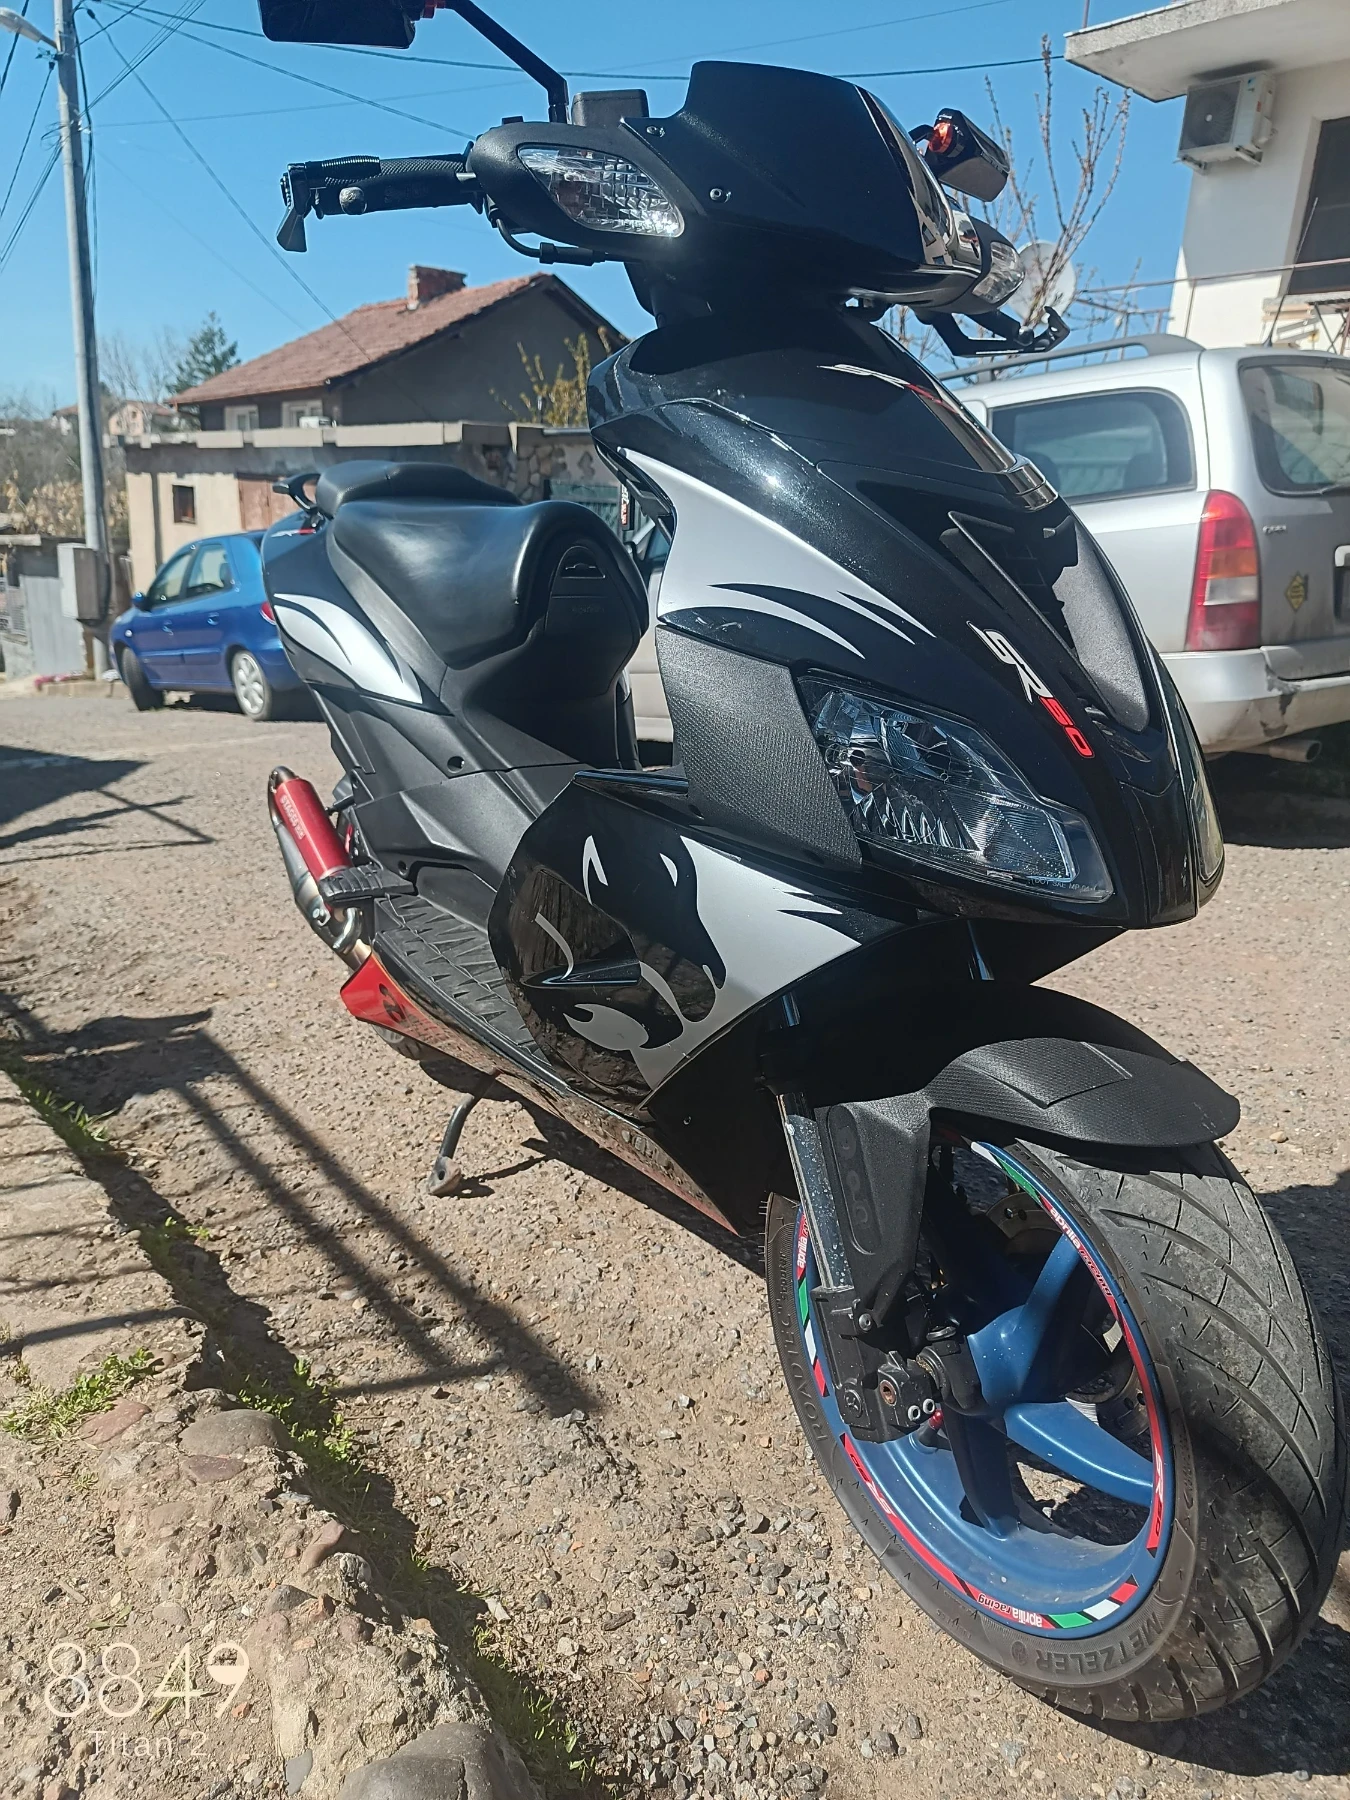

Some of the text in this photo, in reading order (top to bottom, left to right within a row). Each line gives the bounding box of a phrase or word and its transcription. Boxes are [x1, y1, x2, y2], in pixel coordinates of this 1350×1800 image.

[1050, 1207, 1082, 1250] aprilia
[797, 1235, 808, 1269] aprilia
[977, 1592, 1012, 1615] racing
[1012, 1607, 1043, 1628] aprilia
[1035, 1611, 1164, 1677] METZELER
